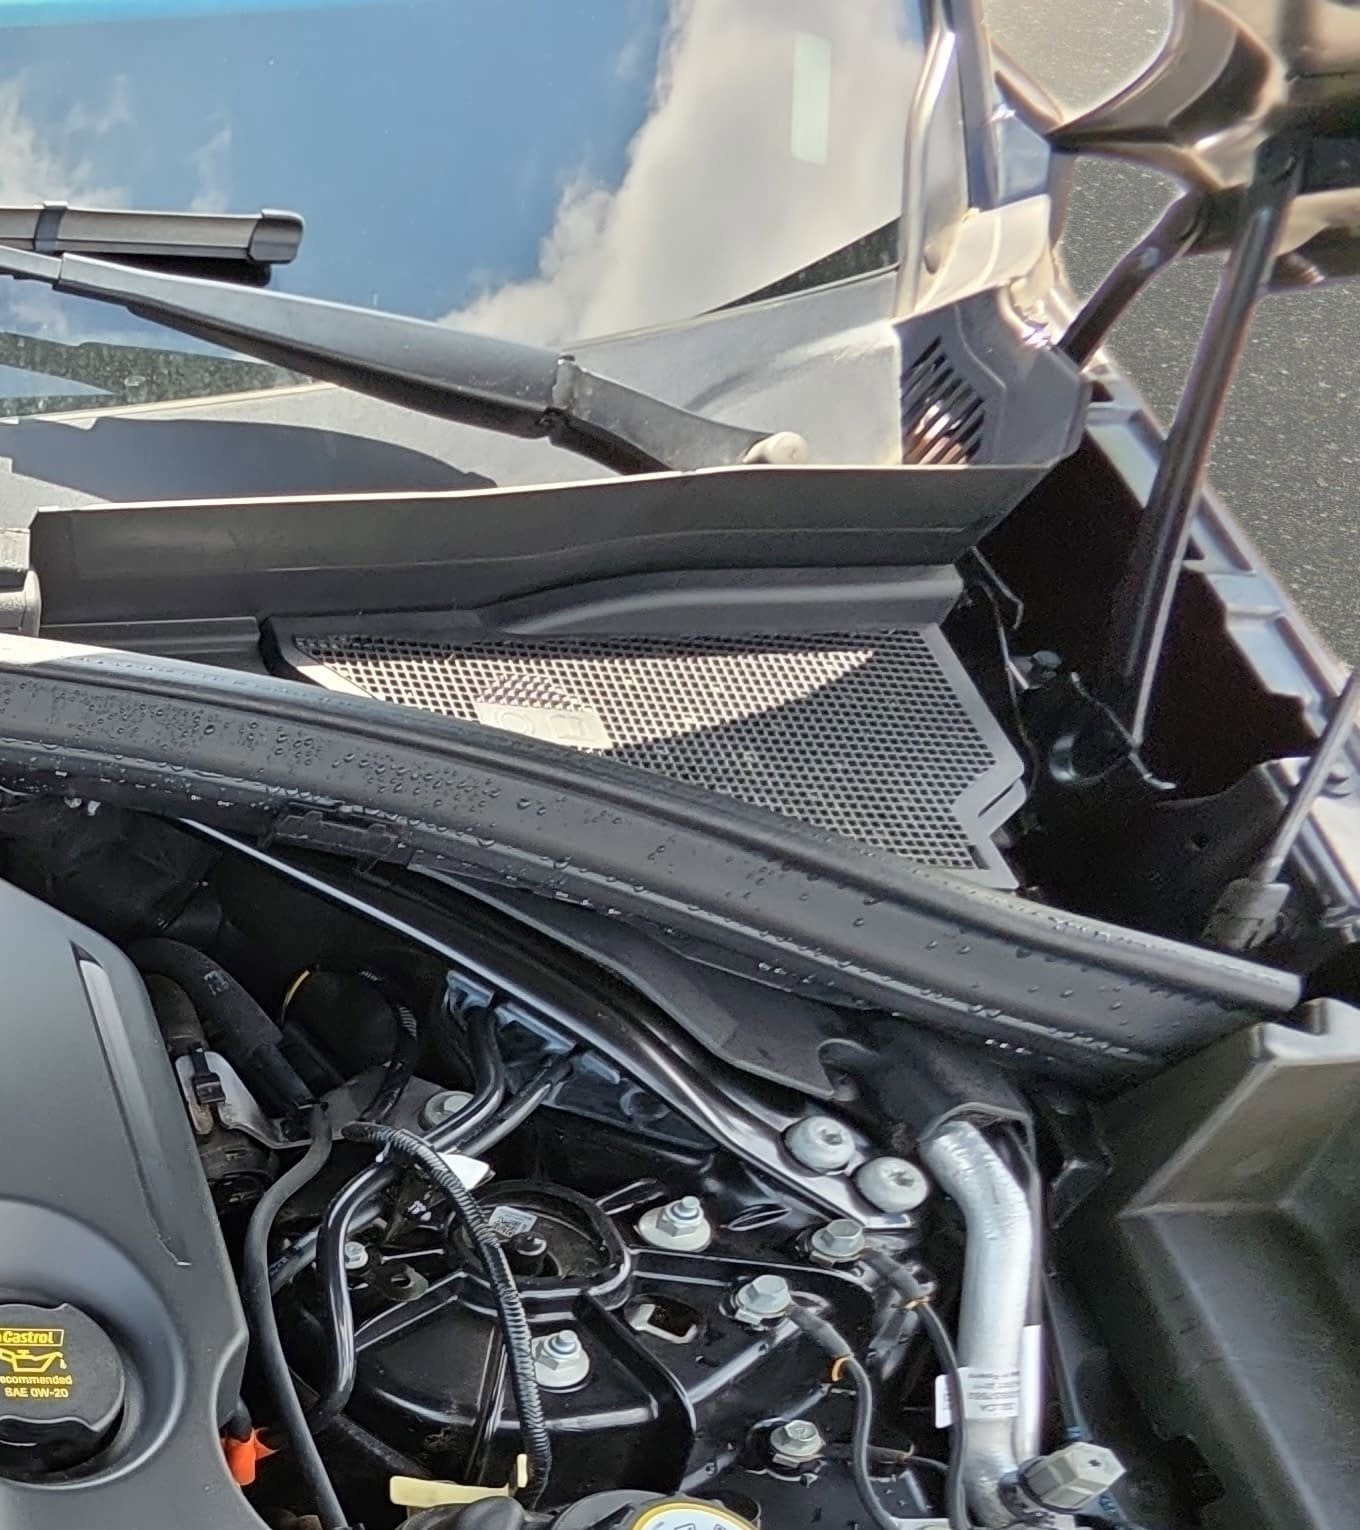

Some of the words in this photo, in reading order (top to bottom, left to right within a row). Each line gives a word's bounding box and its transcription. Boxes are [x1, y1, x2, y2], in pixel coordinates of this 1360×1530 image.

[2, 1330, 54, 1344] Castrol
[4, 1387, 28, 1397] SAE
[30, 1387, 69, 1398] 0W-20
